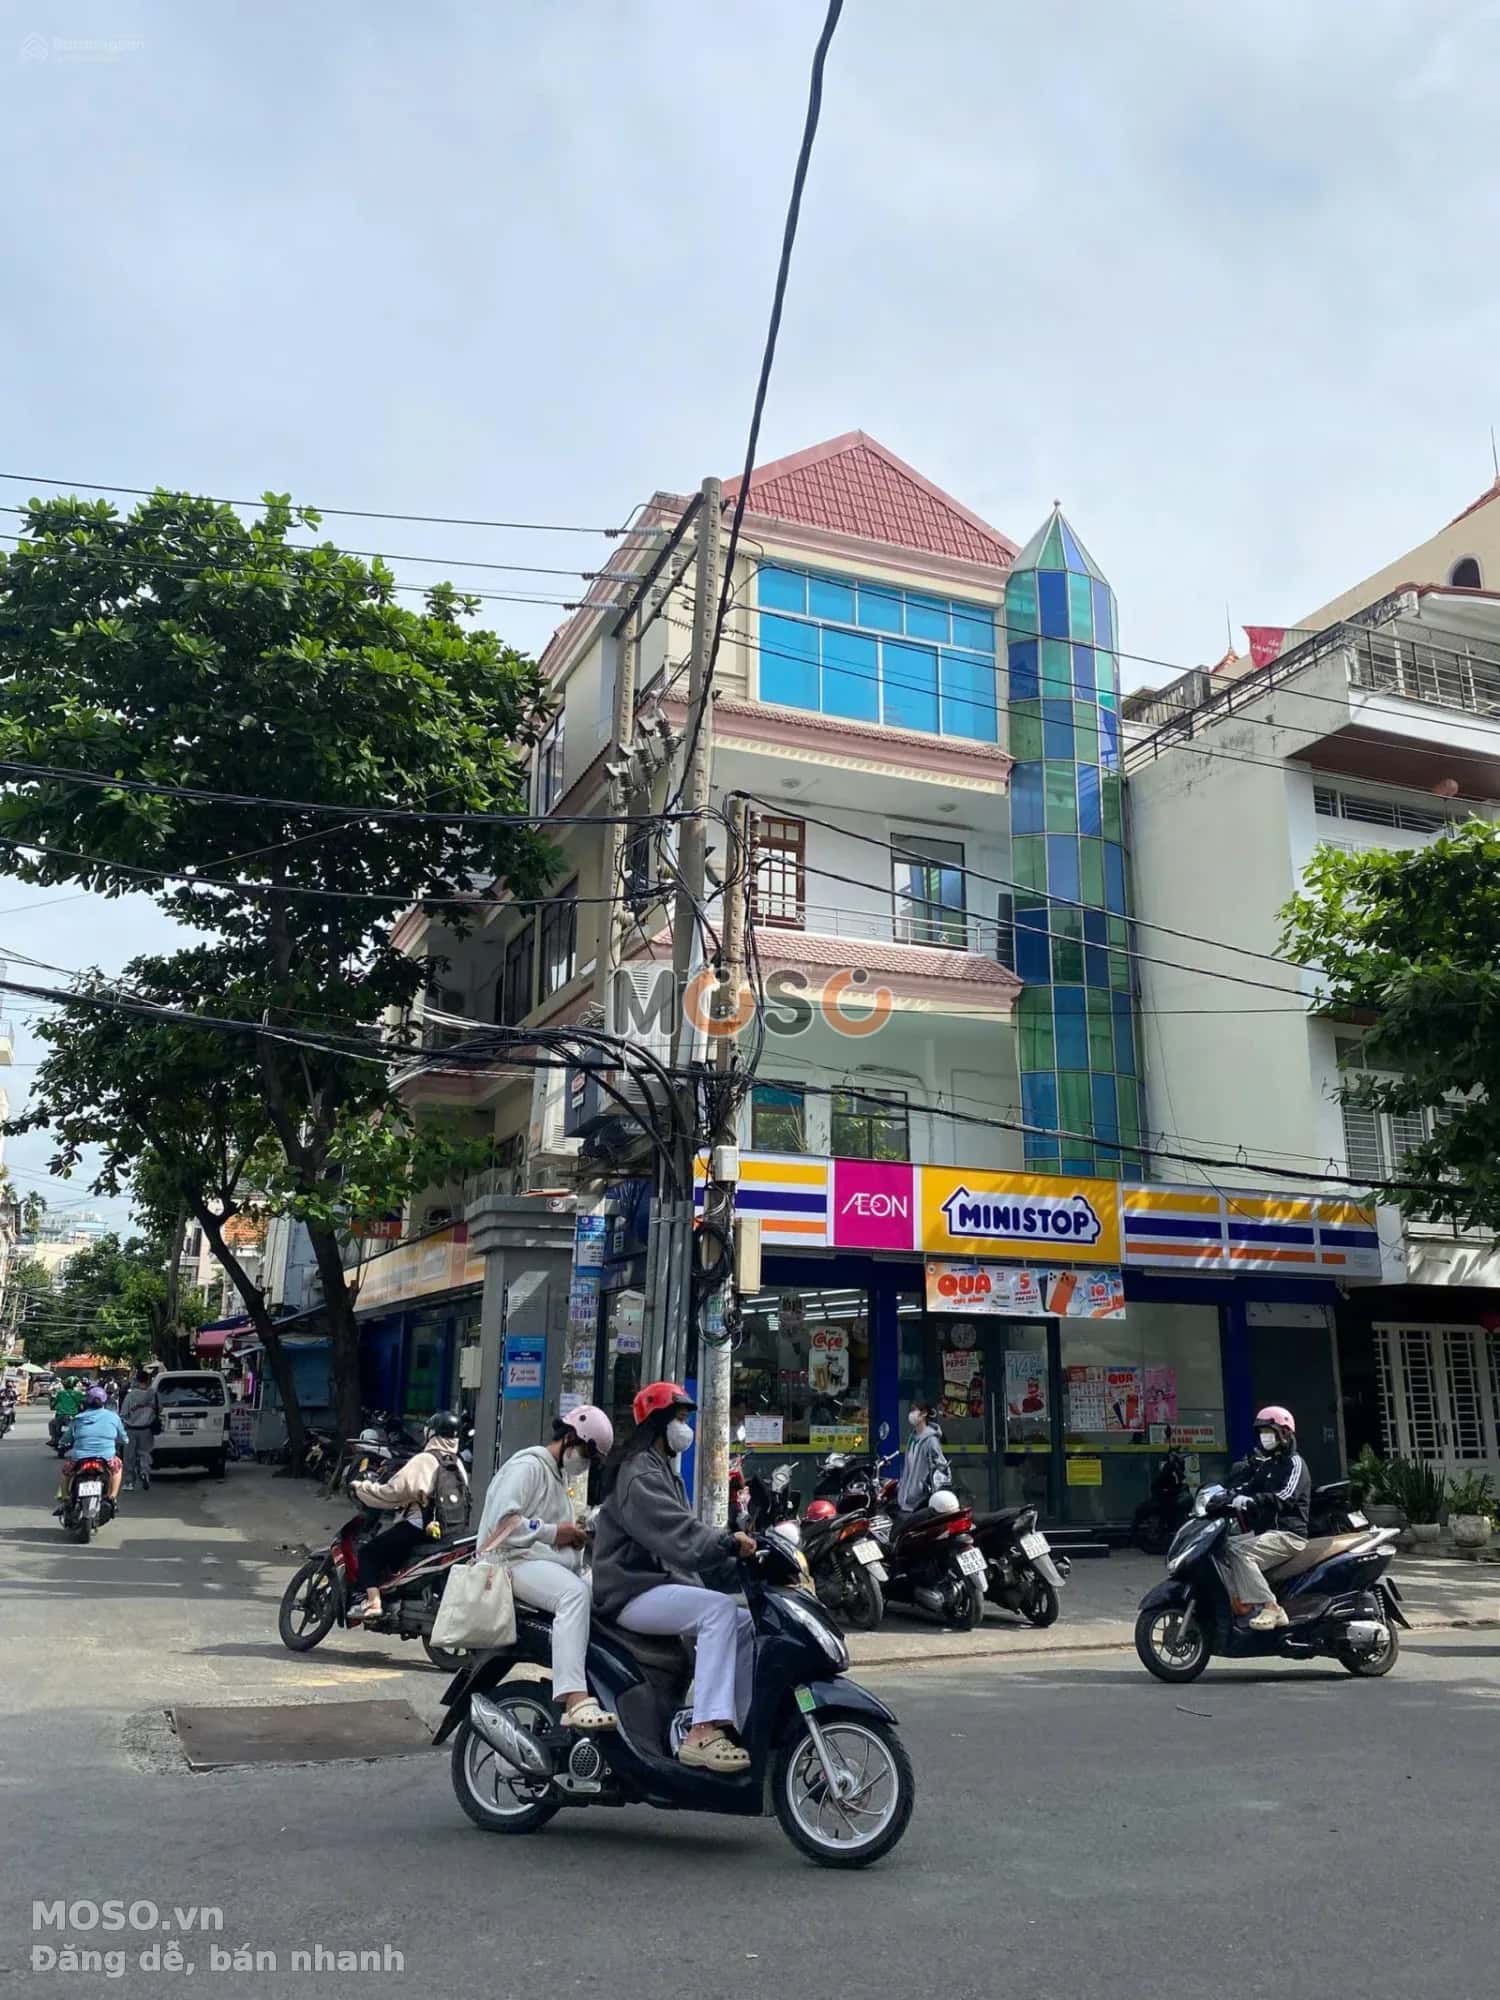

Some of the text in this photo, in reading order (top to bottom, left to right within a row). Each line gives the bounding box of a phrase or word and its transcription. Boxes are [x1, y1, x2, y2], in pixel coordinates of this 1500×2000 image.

[958, 1202, 1090, 1236] MINISTOP
[937, 1266, 992, 1297] QUÀ
[1019, 1272, 1030, 1290] 5
